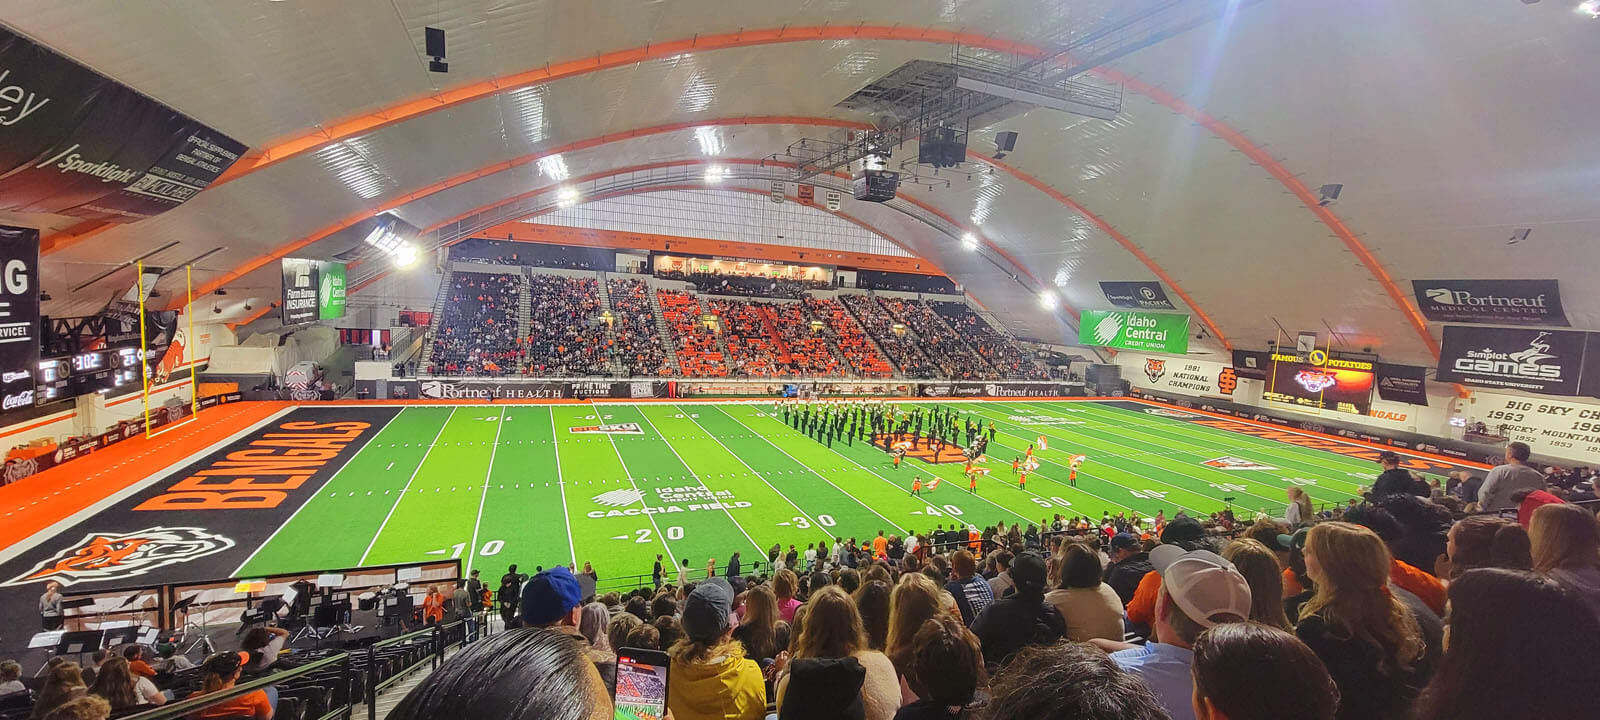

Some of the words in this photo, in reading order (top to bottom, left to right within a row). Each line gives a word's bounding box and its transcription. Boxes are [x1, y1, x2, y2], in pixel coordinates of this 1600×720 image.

[58, 153, 136, 184] Sparklight
[287, 290, 300, 299] Farm
[301, 289, 316, 298] Bureau
[1452, 291, 1545, 308] Portneuf
[287, 298, 317, 309] INSURANCE
[1126, 314, 1157, 328] Idaho
[1125, 327, 1167, 341] Central
[1467, 350, 1508, 360] Simplot
[1271, 353, 1304, 363] FAMOUS
[1327, 360, 1373, 370] POTATOES
[1184, 364, 1201, 372] 1981
[1172, 372, 1208, 382] NATIONAL
[996, 385, 1026, 396] Portneuf
[1168, 380, 1211, 392] CHAMPIONS
[1505, 381, 1544, 390] UNIVERSITY
[506, 389, 561, 398] HEALTH
[1505, 400, 1533, 411] BIG
[1537, 404, 1574, 416] SKY
[1487, 410, 1525, 422] 1963
[131, 420, 371, 511] BENGALS
[1031, 496, 1072, 508] 50
[587, 505, 685, 518] CACCIA
[688, 501, 752, 511] FIELD
[925, 504, 963, 517] 40
[792, 514, 837, 529] 30
[635, 526, 684, 543] 20
